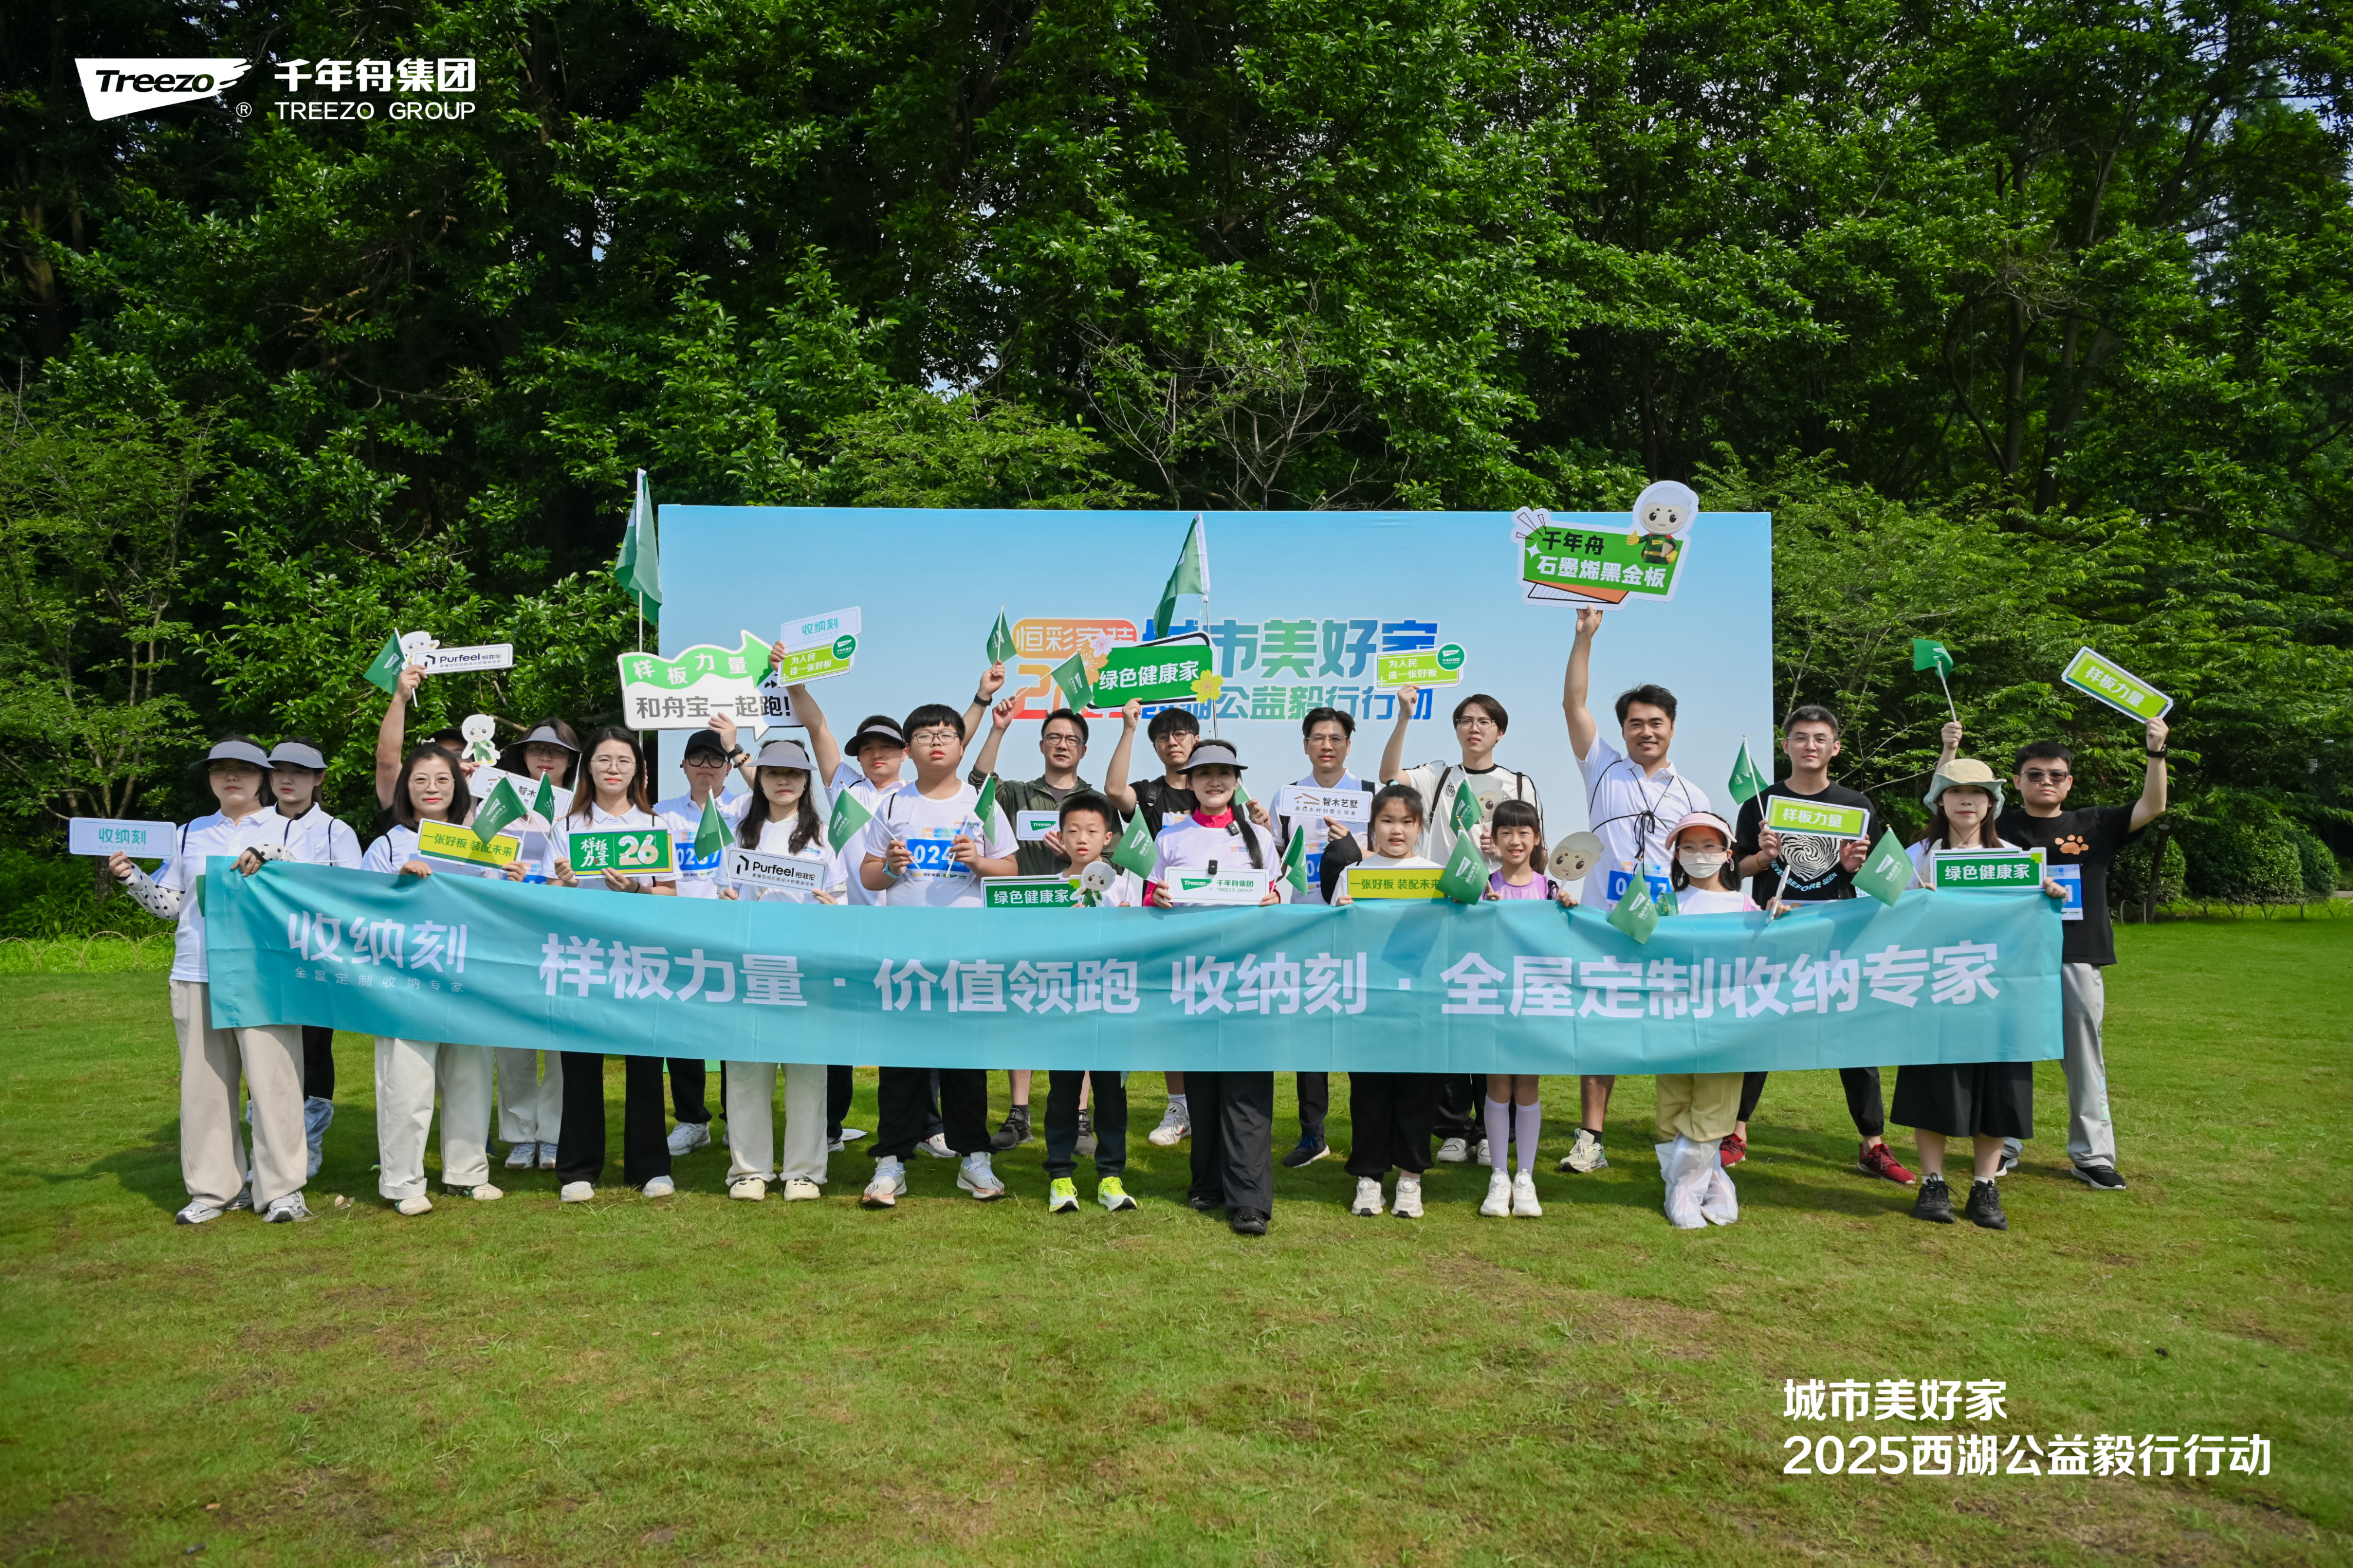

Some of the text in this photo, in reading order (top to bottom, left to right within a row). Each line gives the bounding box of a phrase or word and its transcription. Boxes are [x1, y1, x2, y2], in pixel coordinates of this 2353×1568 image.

[1542, 531, 1605, 556] 千年舟
[1537, 555, 1667, 588] 石墨烯黑金板
[802, 618, 838, 635] 收纳刻
[440, 653, 480, 663] Purfeel
[790, 659, 832, 675] 造一张好板
[791, 653, 815, 665] 为人民
[1388, 659, 1417, 669] 为人民
[632, 653, 748, 685] 样板力量
[1099, 660, 1199, 690] 绿色健康家
[1388, 668, 1437, 680] 造一张好板
[2085, 666, 2145, 708] 样板力量
[636, 695, 791, 719] 和舟宝一起跑!
[1323, 798, 1358, 808] 智木艺墅
[1782, 808, 1842, 828] 样板力量
[99, 828, 146, 845] 收纳刻
[423, 833, 512, 857] 一张好板 装配未来
[618, 834, 659, 866] 26
[753, 862, 815, 880] Purfeel 柏菲伦
[1771, 860, 1838, 891] NEVE BEFORE SEEN
[1945, 864, 2030, 881] 绿色健康家
[1349, 879, 1394, 889] 一张好板
[994, 889, 1070, 905] 绿色健康家
[288, 911, 467, 974] 收纳刻
[294, 966, 464, 994] 全屋定制收纳专家
